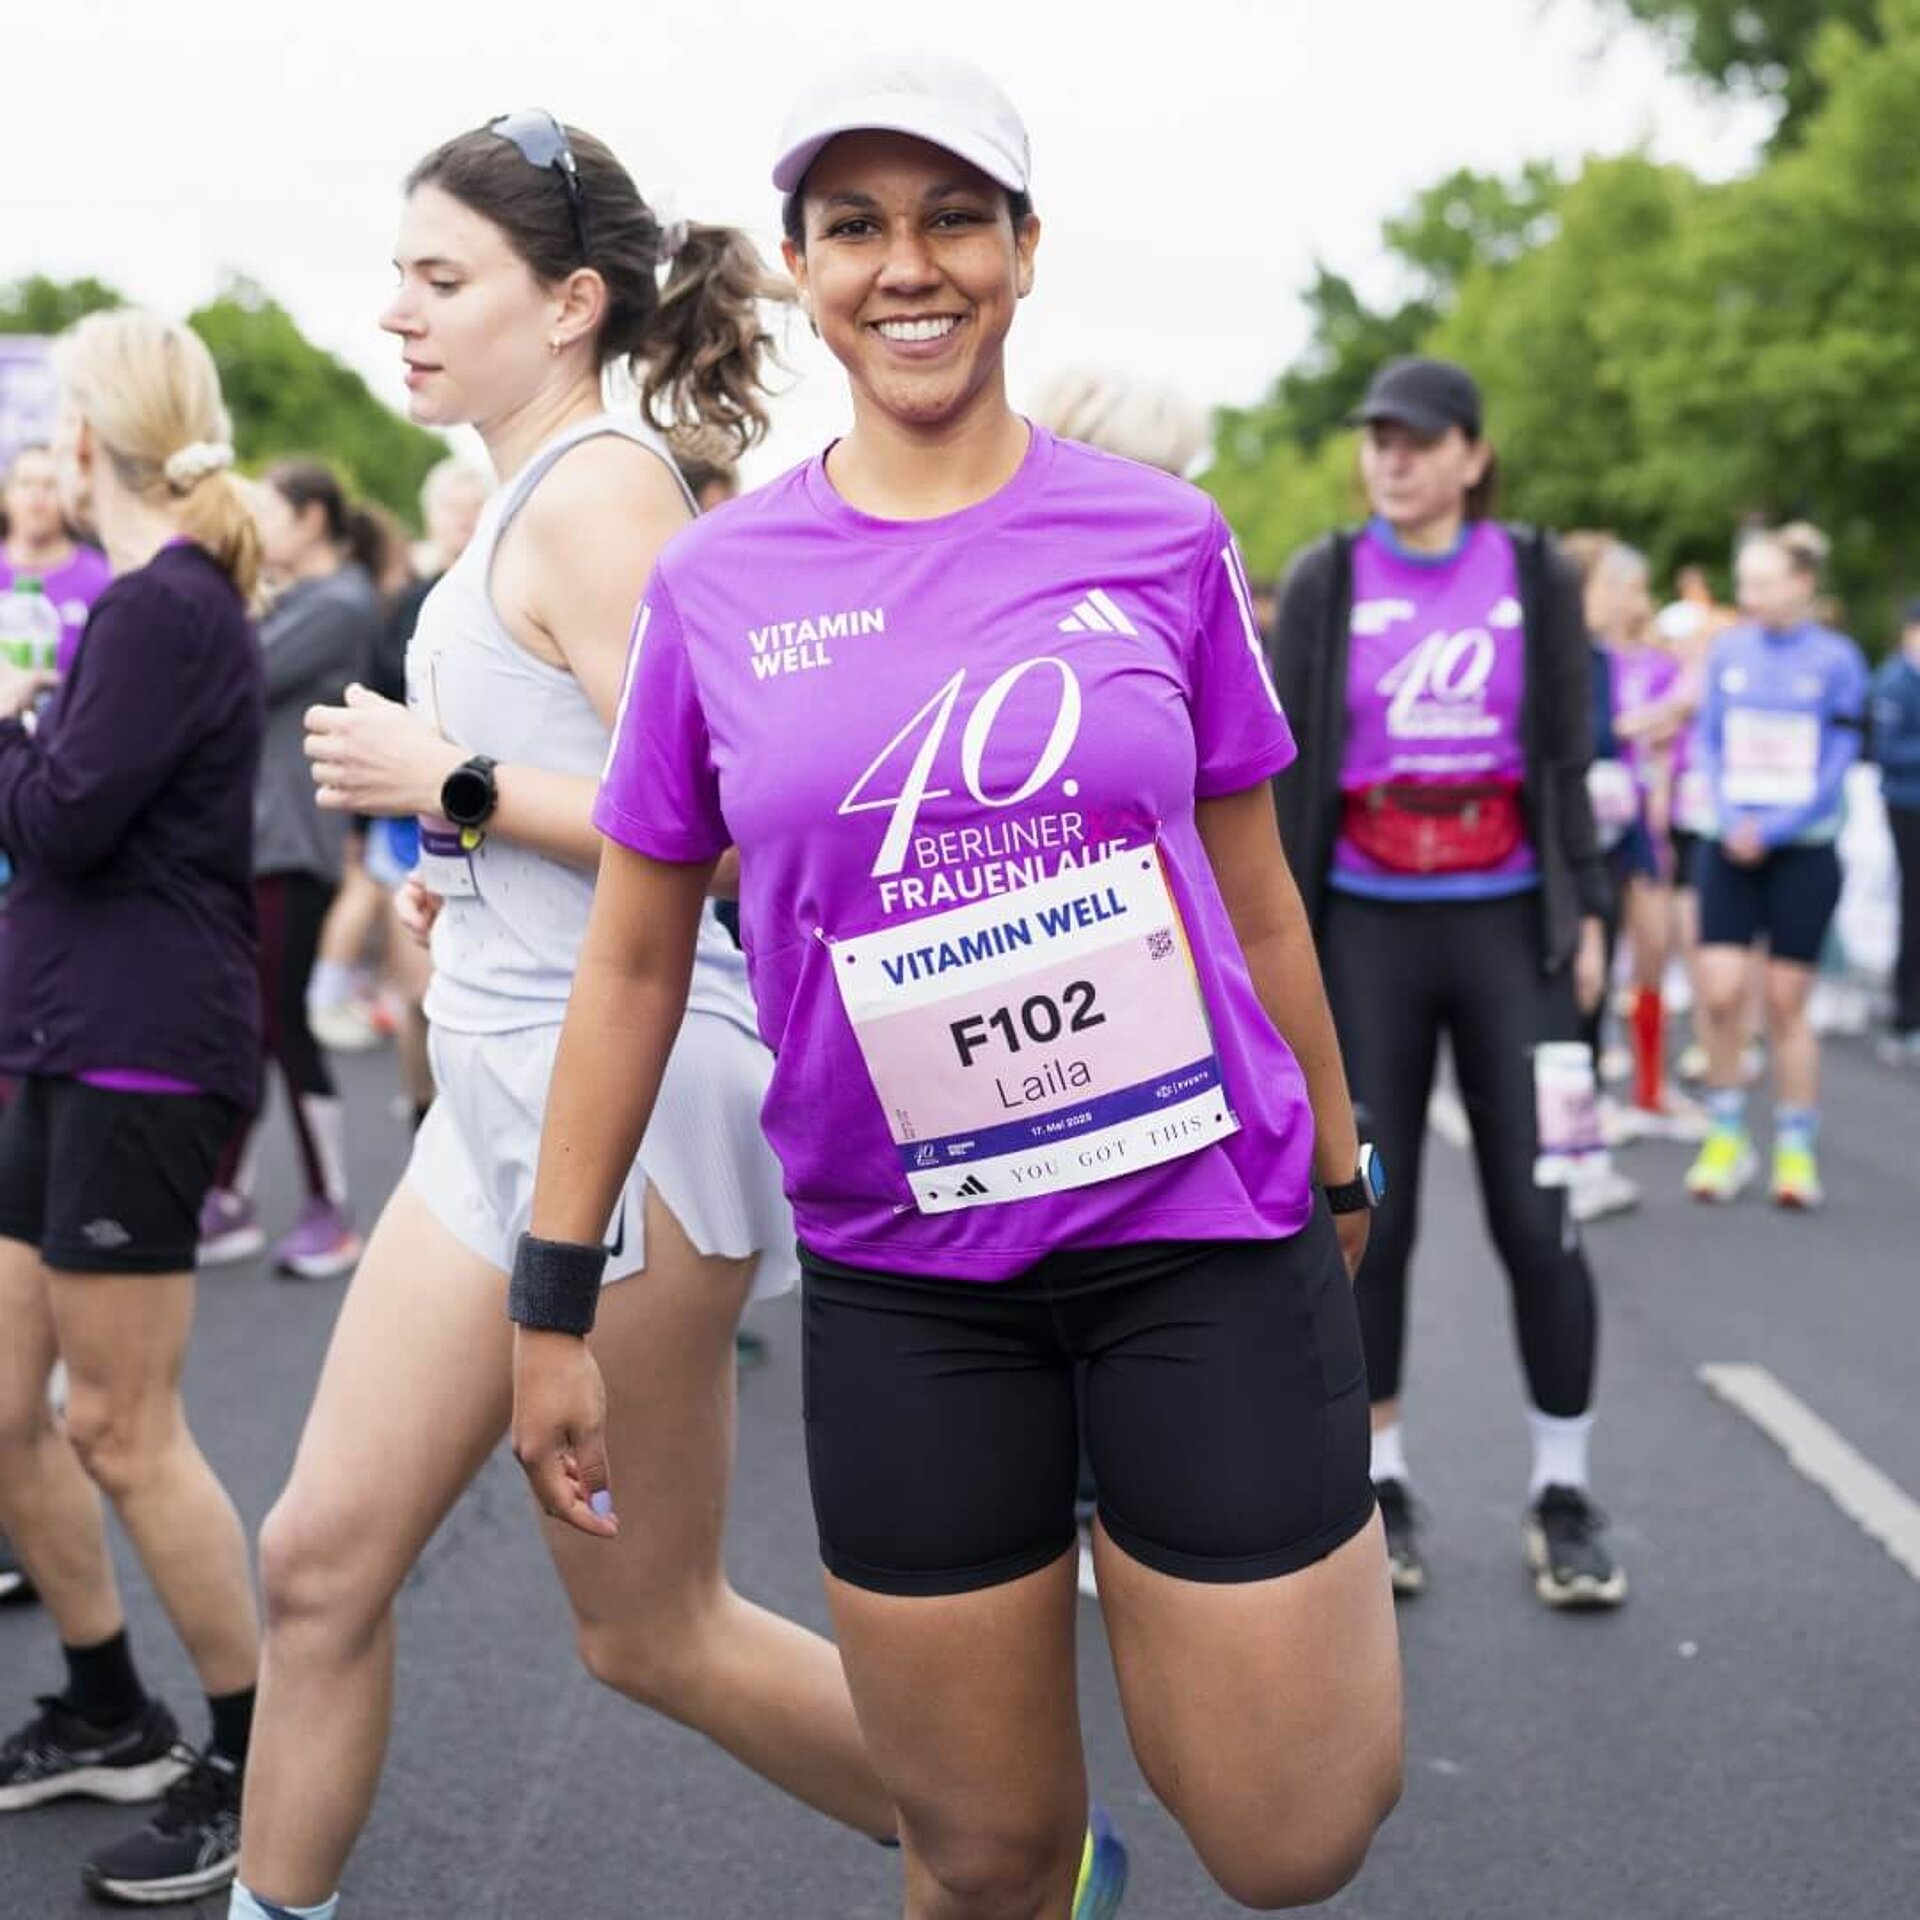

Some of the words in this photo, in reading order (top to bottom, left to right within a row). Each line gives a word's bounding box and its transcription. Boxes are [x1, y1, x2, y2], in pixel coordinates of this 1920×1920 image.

[748, 607, 885, 653] VITAMIN
[751, 642, 832, 681] WELL
[838, 656, 1082, 879] 40.
[914, 812, 1084, 869] BERLINER
[881, 918, 1032, 986] VITAMIN
[1035, 887, 1128, 938] WELL
[949, 980, 1106, 1067] F102
[995, 1059, 1091, 1108] Laila
[1010, 1159, 1059, 1183] YOU
[1078, 1138, 1128, 1167] GOT
[1145, 1114, 1202, 1147] THIS
